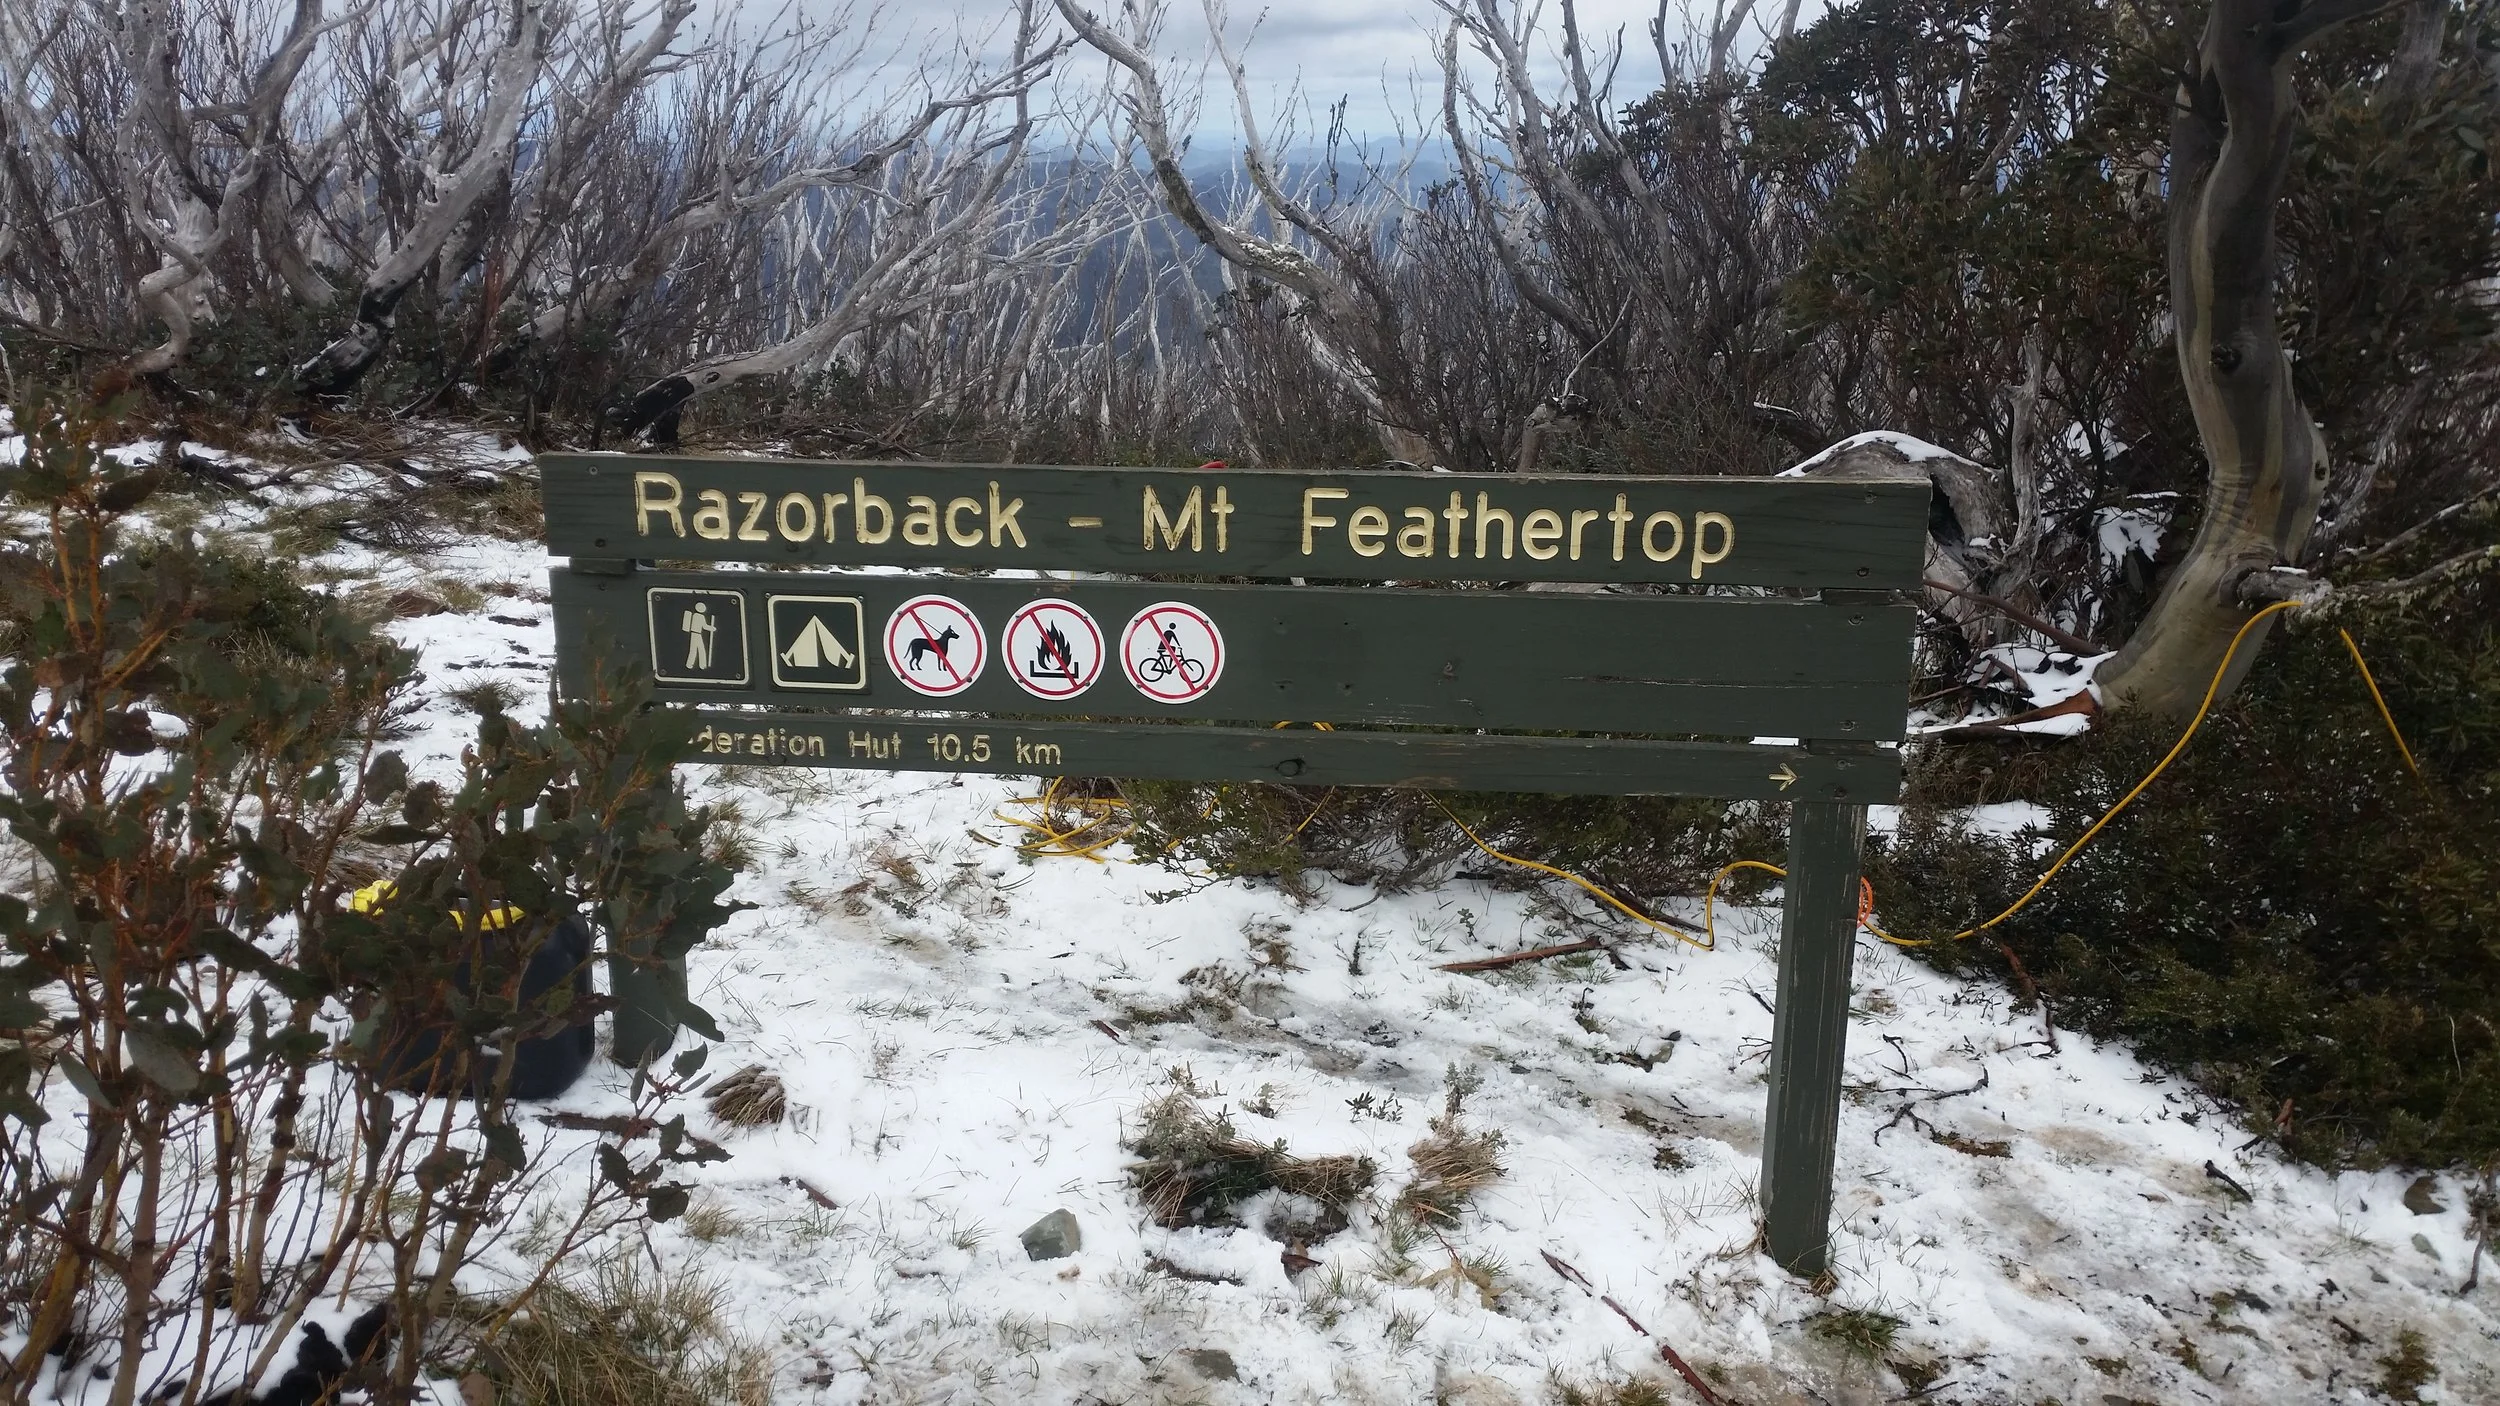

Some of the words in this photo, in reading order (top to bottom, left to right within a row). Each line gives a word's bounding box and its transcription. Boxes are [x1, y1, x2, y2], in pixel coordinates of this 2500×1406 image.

[634, 471, 1028, 549] Razorback
[1142, 484, 1235, 553] Mt
[1301, 487, 1737, 580] Feathertop
[687, 724, 826, 758] deration
[848, 730, 901, 760] Hut
[927, 732, 992, 763] 10.5
[1015, 735, 1062, 766] km
